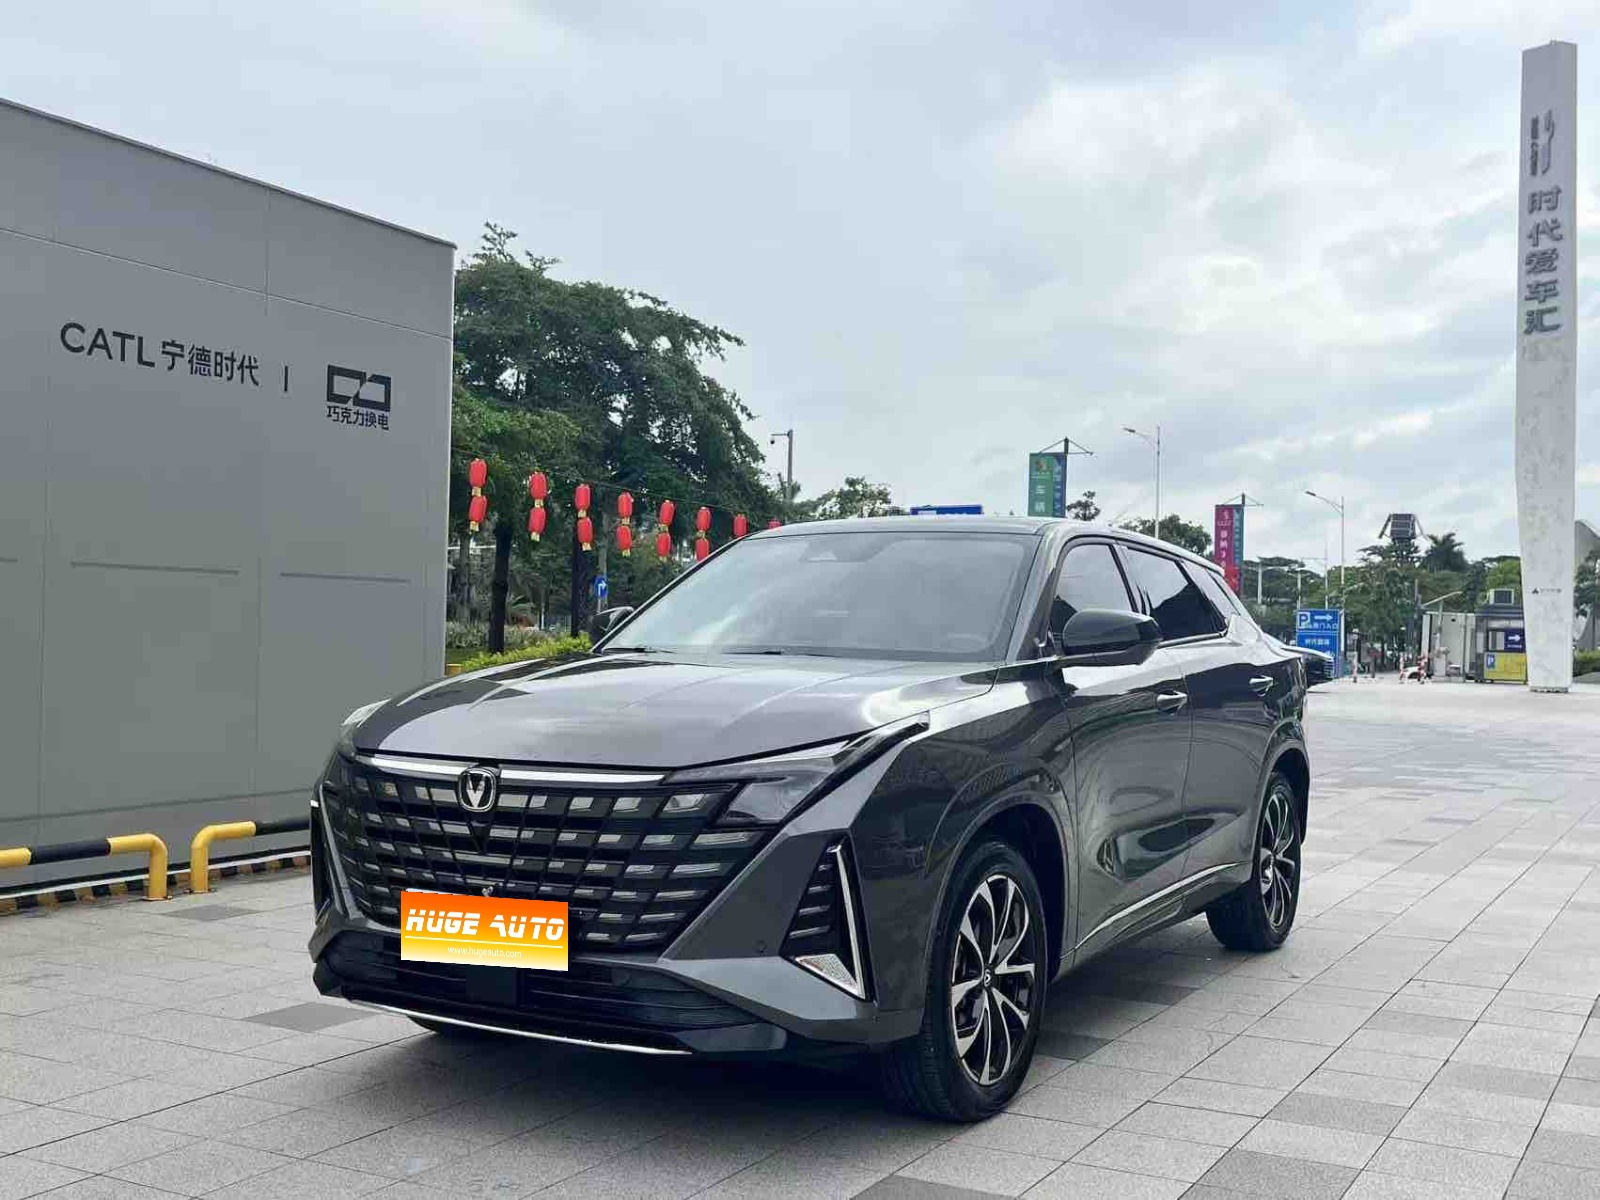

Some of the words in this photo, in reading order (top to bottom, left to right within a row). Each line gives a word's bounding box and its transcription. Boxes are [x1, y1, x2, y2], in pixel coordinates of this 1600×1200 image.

[60, 322, 156, 368] CATL
[161, 339, 260, 387] 宁德时代
[326, 405, 390, 430] 巧克力换电
